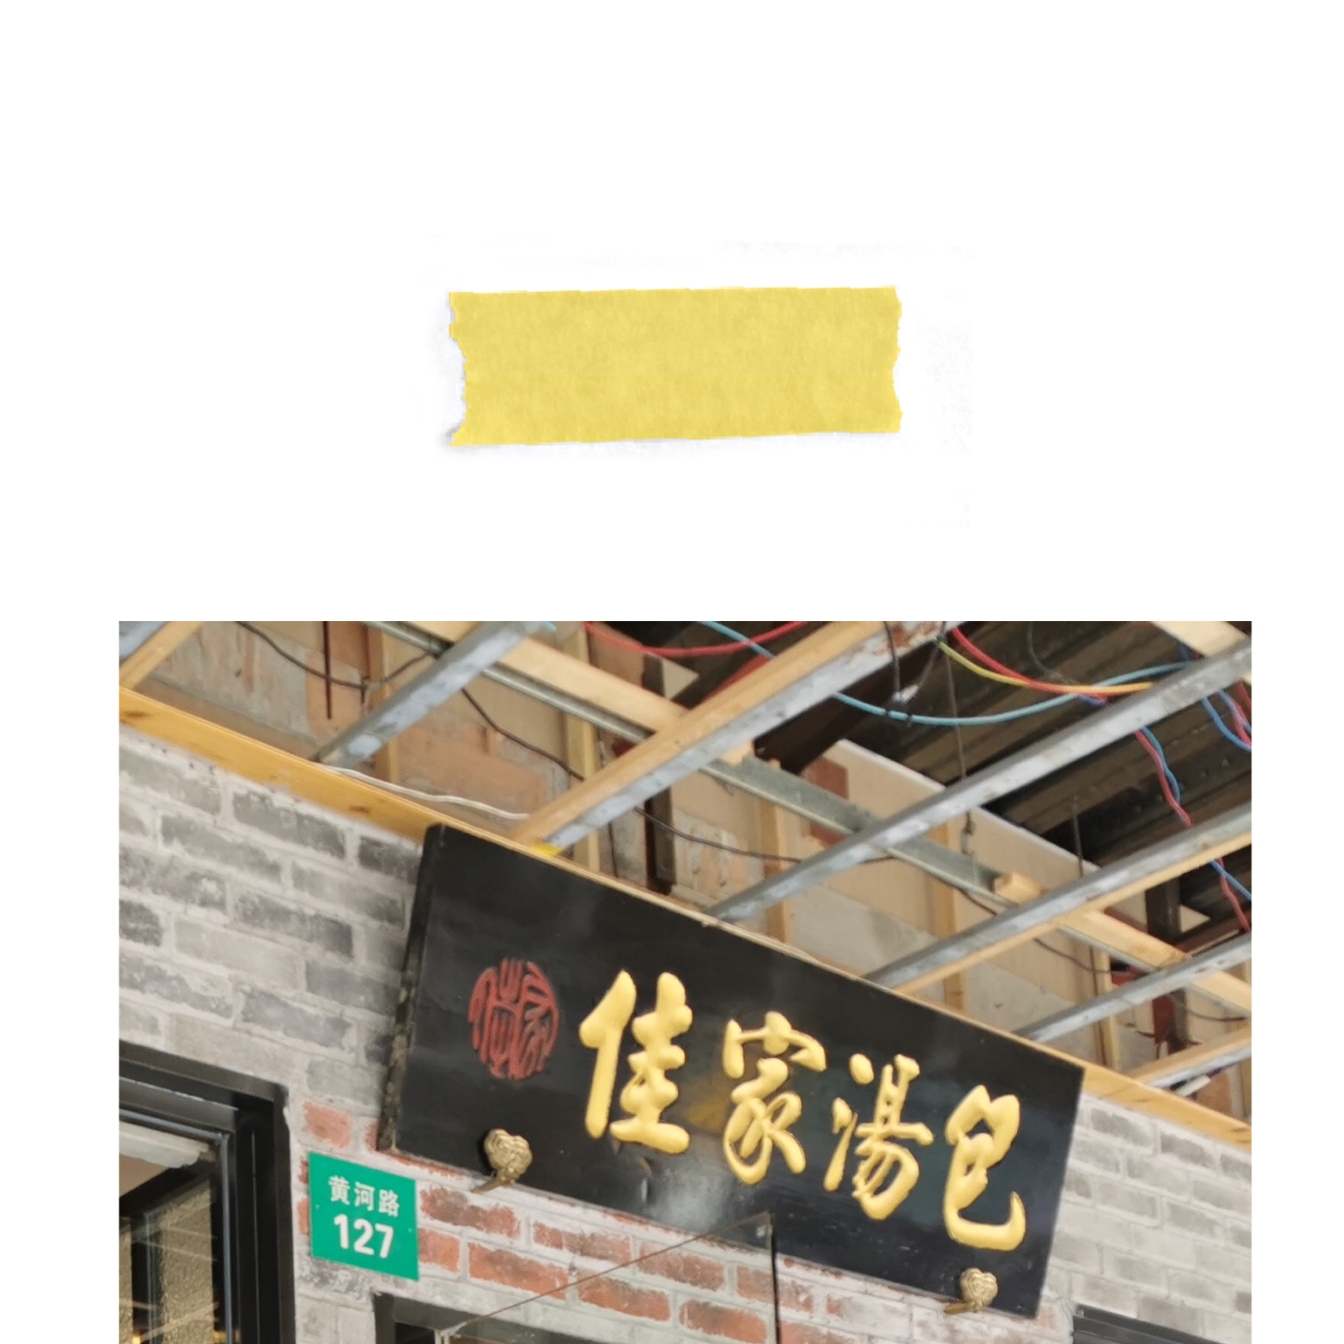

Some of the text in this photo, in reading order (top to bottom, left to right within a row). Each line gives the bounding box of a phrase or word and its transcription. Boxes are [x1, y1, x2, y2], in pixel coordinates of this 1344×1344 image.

[579, 968, 1027, 1252] 佳家湯包
[328, 1174, 400, 1218] 黄河路
[333, 1213, 394, 1259] 127
